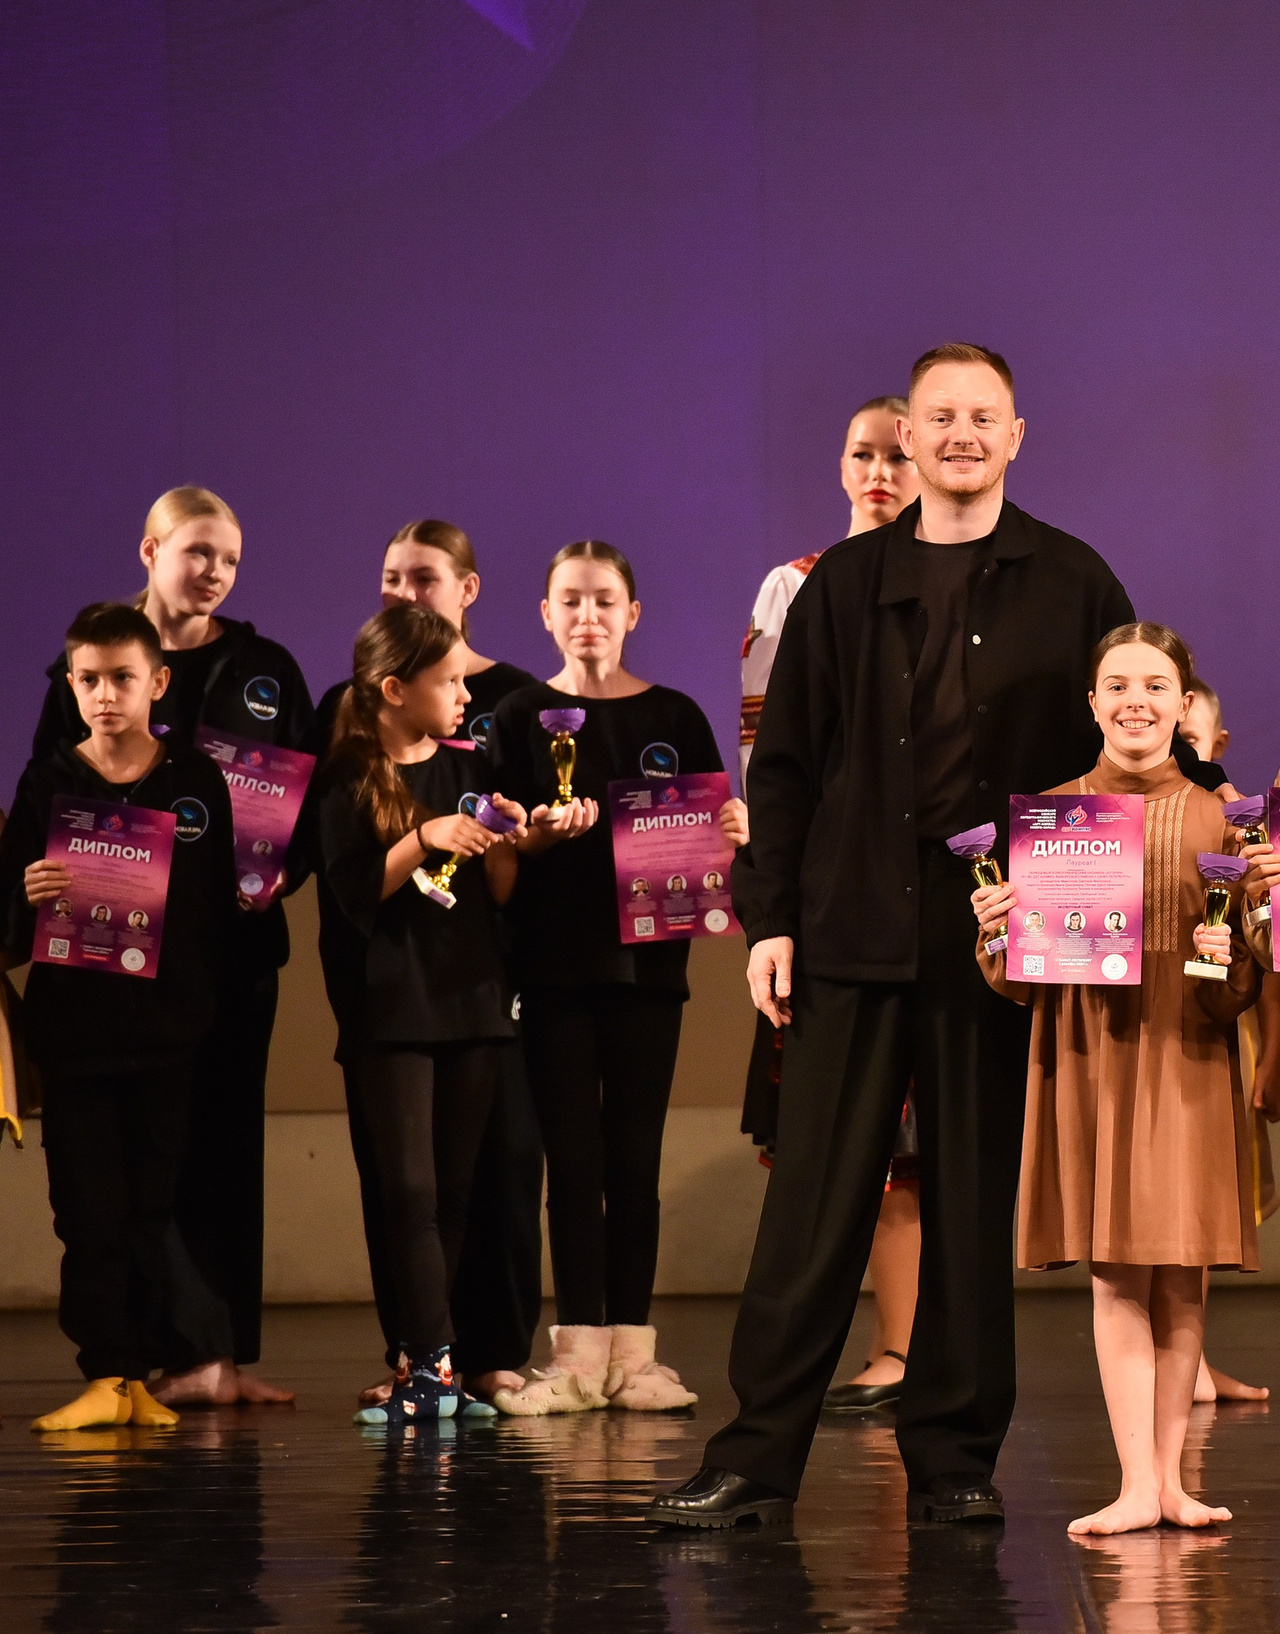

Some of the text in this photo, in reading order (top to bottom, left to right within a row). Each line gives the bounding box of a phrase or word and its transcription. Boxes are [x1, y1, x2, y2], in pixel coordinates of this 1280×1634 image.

[222, 770, 285, 798] ИПЛОМ
[632, 812, 712, 833] ДИПЛОМ
[68, 837, 151, 863] ДИПЛОМ
[1032, 840, 1120, 857] ДИПЛОМ
